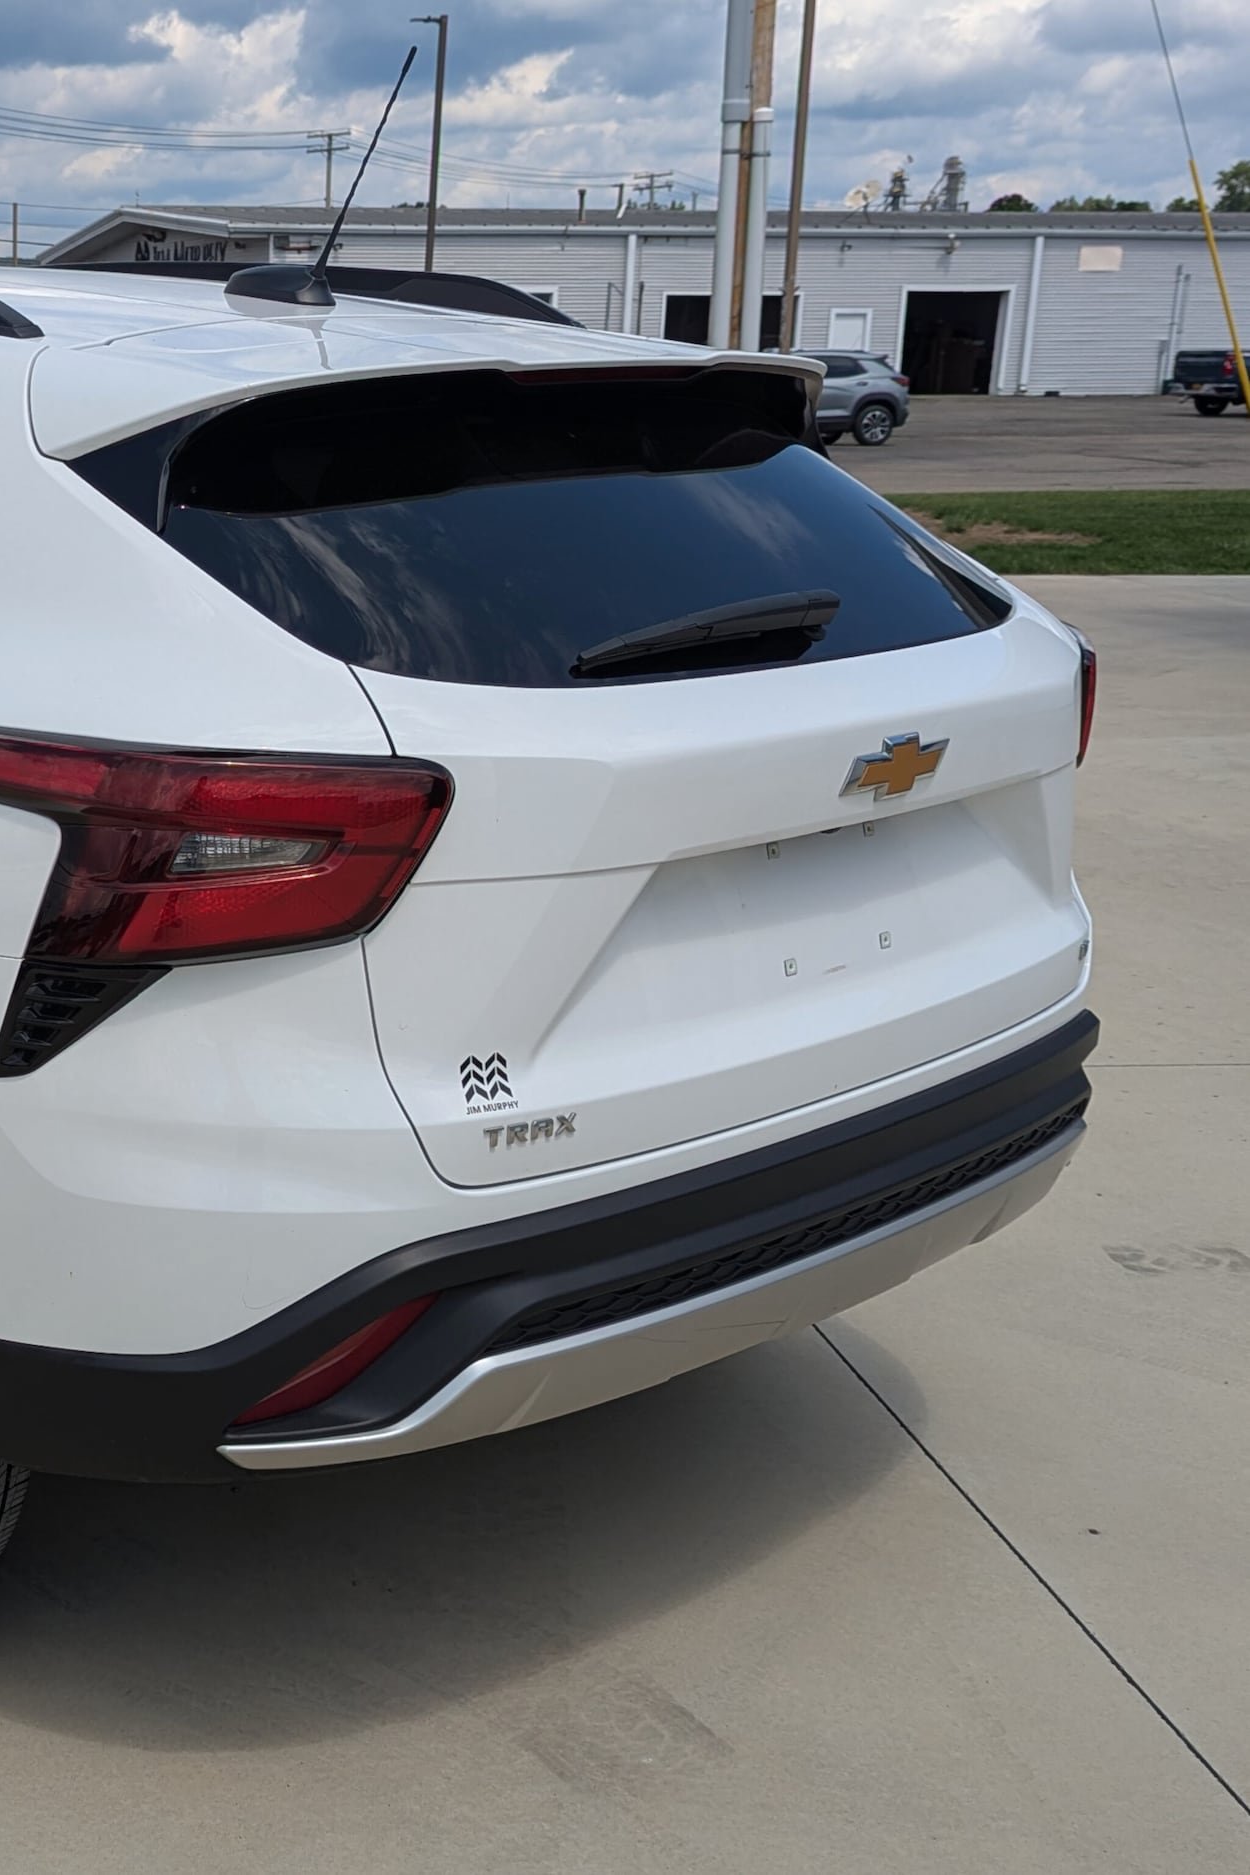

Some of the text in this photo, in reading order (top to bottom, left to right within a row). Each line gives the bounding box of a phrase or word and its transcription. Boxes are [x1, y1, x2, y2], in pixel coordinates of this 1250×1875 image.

[466, 1100, 519, 1115] JIM MURPHY
[483, 1112, 577, 1149] TRAX
